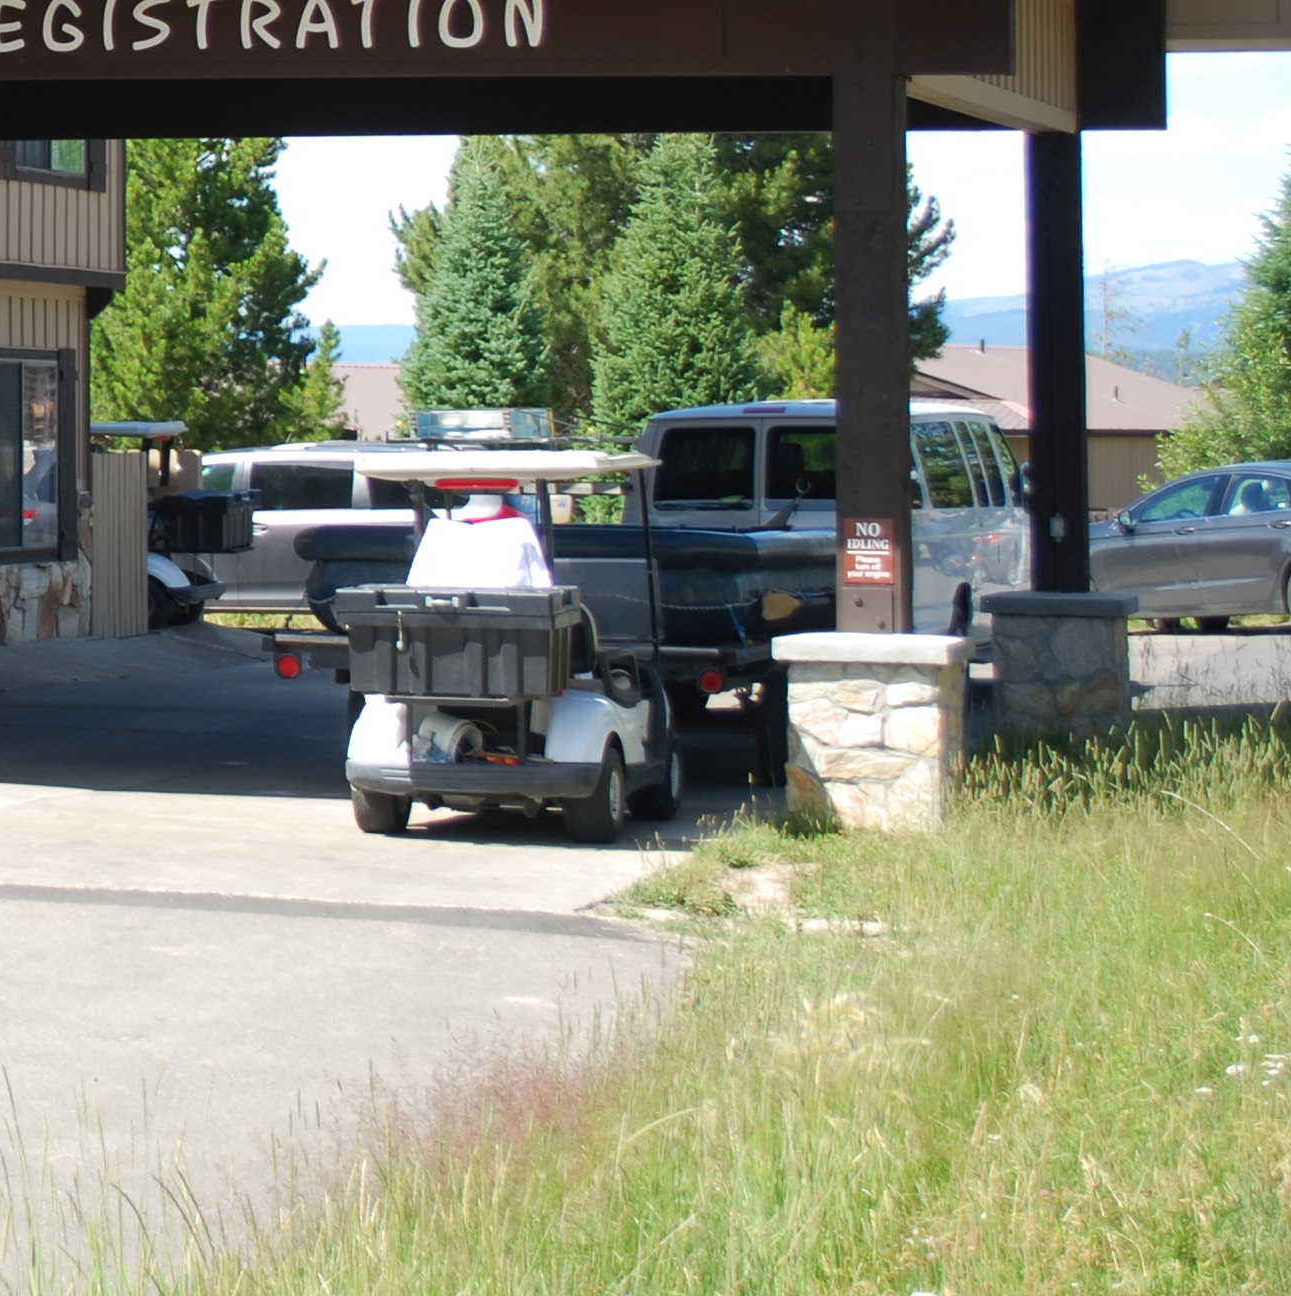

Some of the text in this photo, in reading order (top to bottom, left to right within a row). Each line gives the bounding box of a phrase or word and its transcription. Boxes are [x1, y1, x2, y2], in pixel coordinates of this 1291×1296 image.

[855, 522, 881, 537] NO
[847, 538, 889, 550] IDLING
[855, 555, 881, 563] Please
[847, 571, 890, 579] your engine
